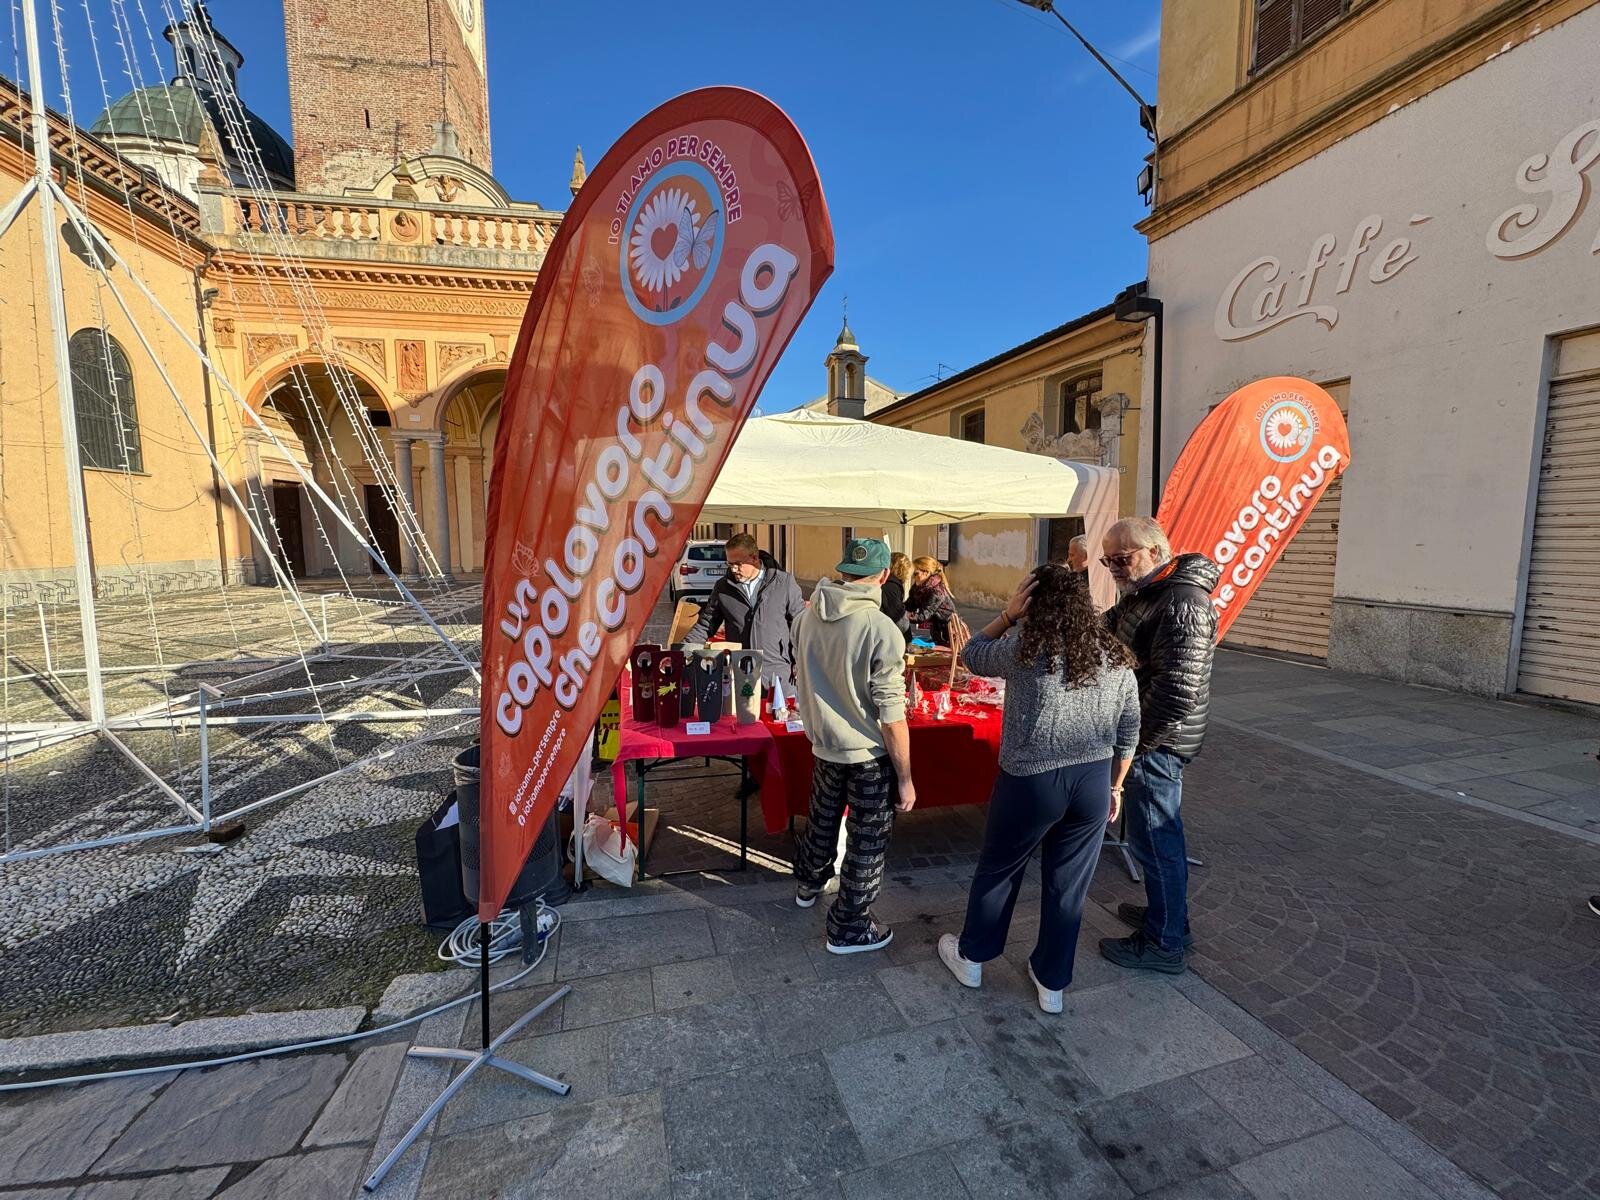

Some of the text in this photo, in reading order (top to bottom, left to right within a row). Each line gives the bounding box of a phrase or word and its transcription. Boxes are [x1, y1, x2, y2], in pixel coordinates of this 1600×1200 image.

[608, 134, 742, 244] IO TI AMO PER SEMPRE
[1485, 118, 1600, 261] S
[555, 243, 800, 710] che continua
[1213, 474, 1282, 574] avoro
[1231, 445, 1342, 588] continua
[496, 363, 666, 736] capolavoro
[500, 577, 538, 640] un
[514, 709, 561, 804] iotiamo_persempre
[523, 727, 567, 816] iotiamopersempre
